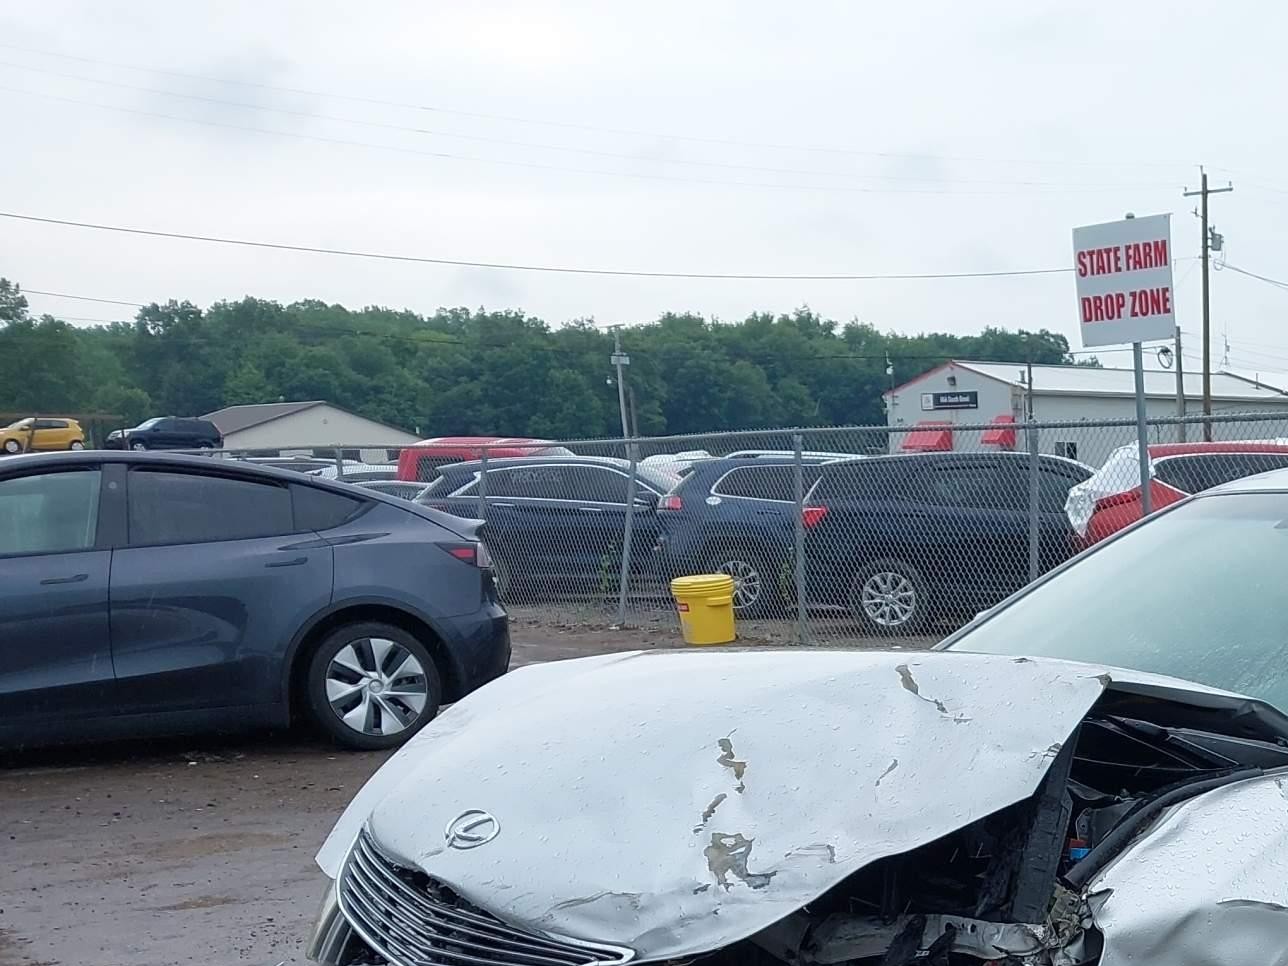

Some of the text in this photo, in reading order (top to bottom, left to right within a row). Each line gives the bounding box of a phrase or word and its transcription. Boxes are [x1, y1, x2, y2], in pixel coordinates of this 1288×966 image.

[1077, 239, 1168, 278] STATE FARM
[1081, 287, 1171, 323] DROP ZONE
